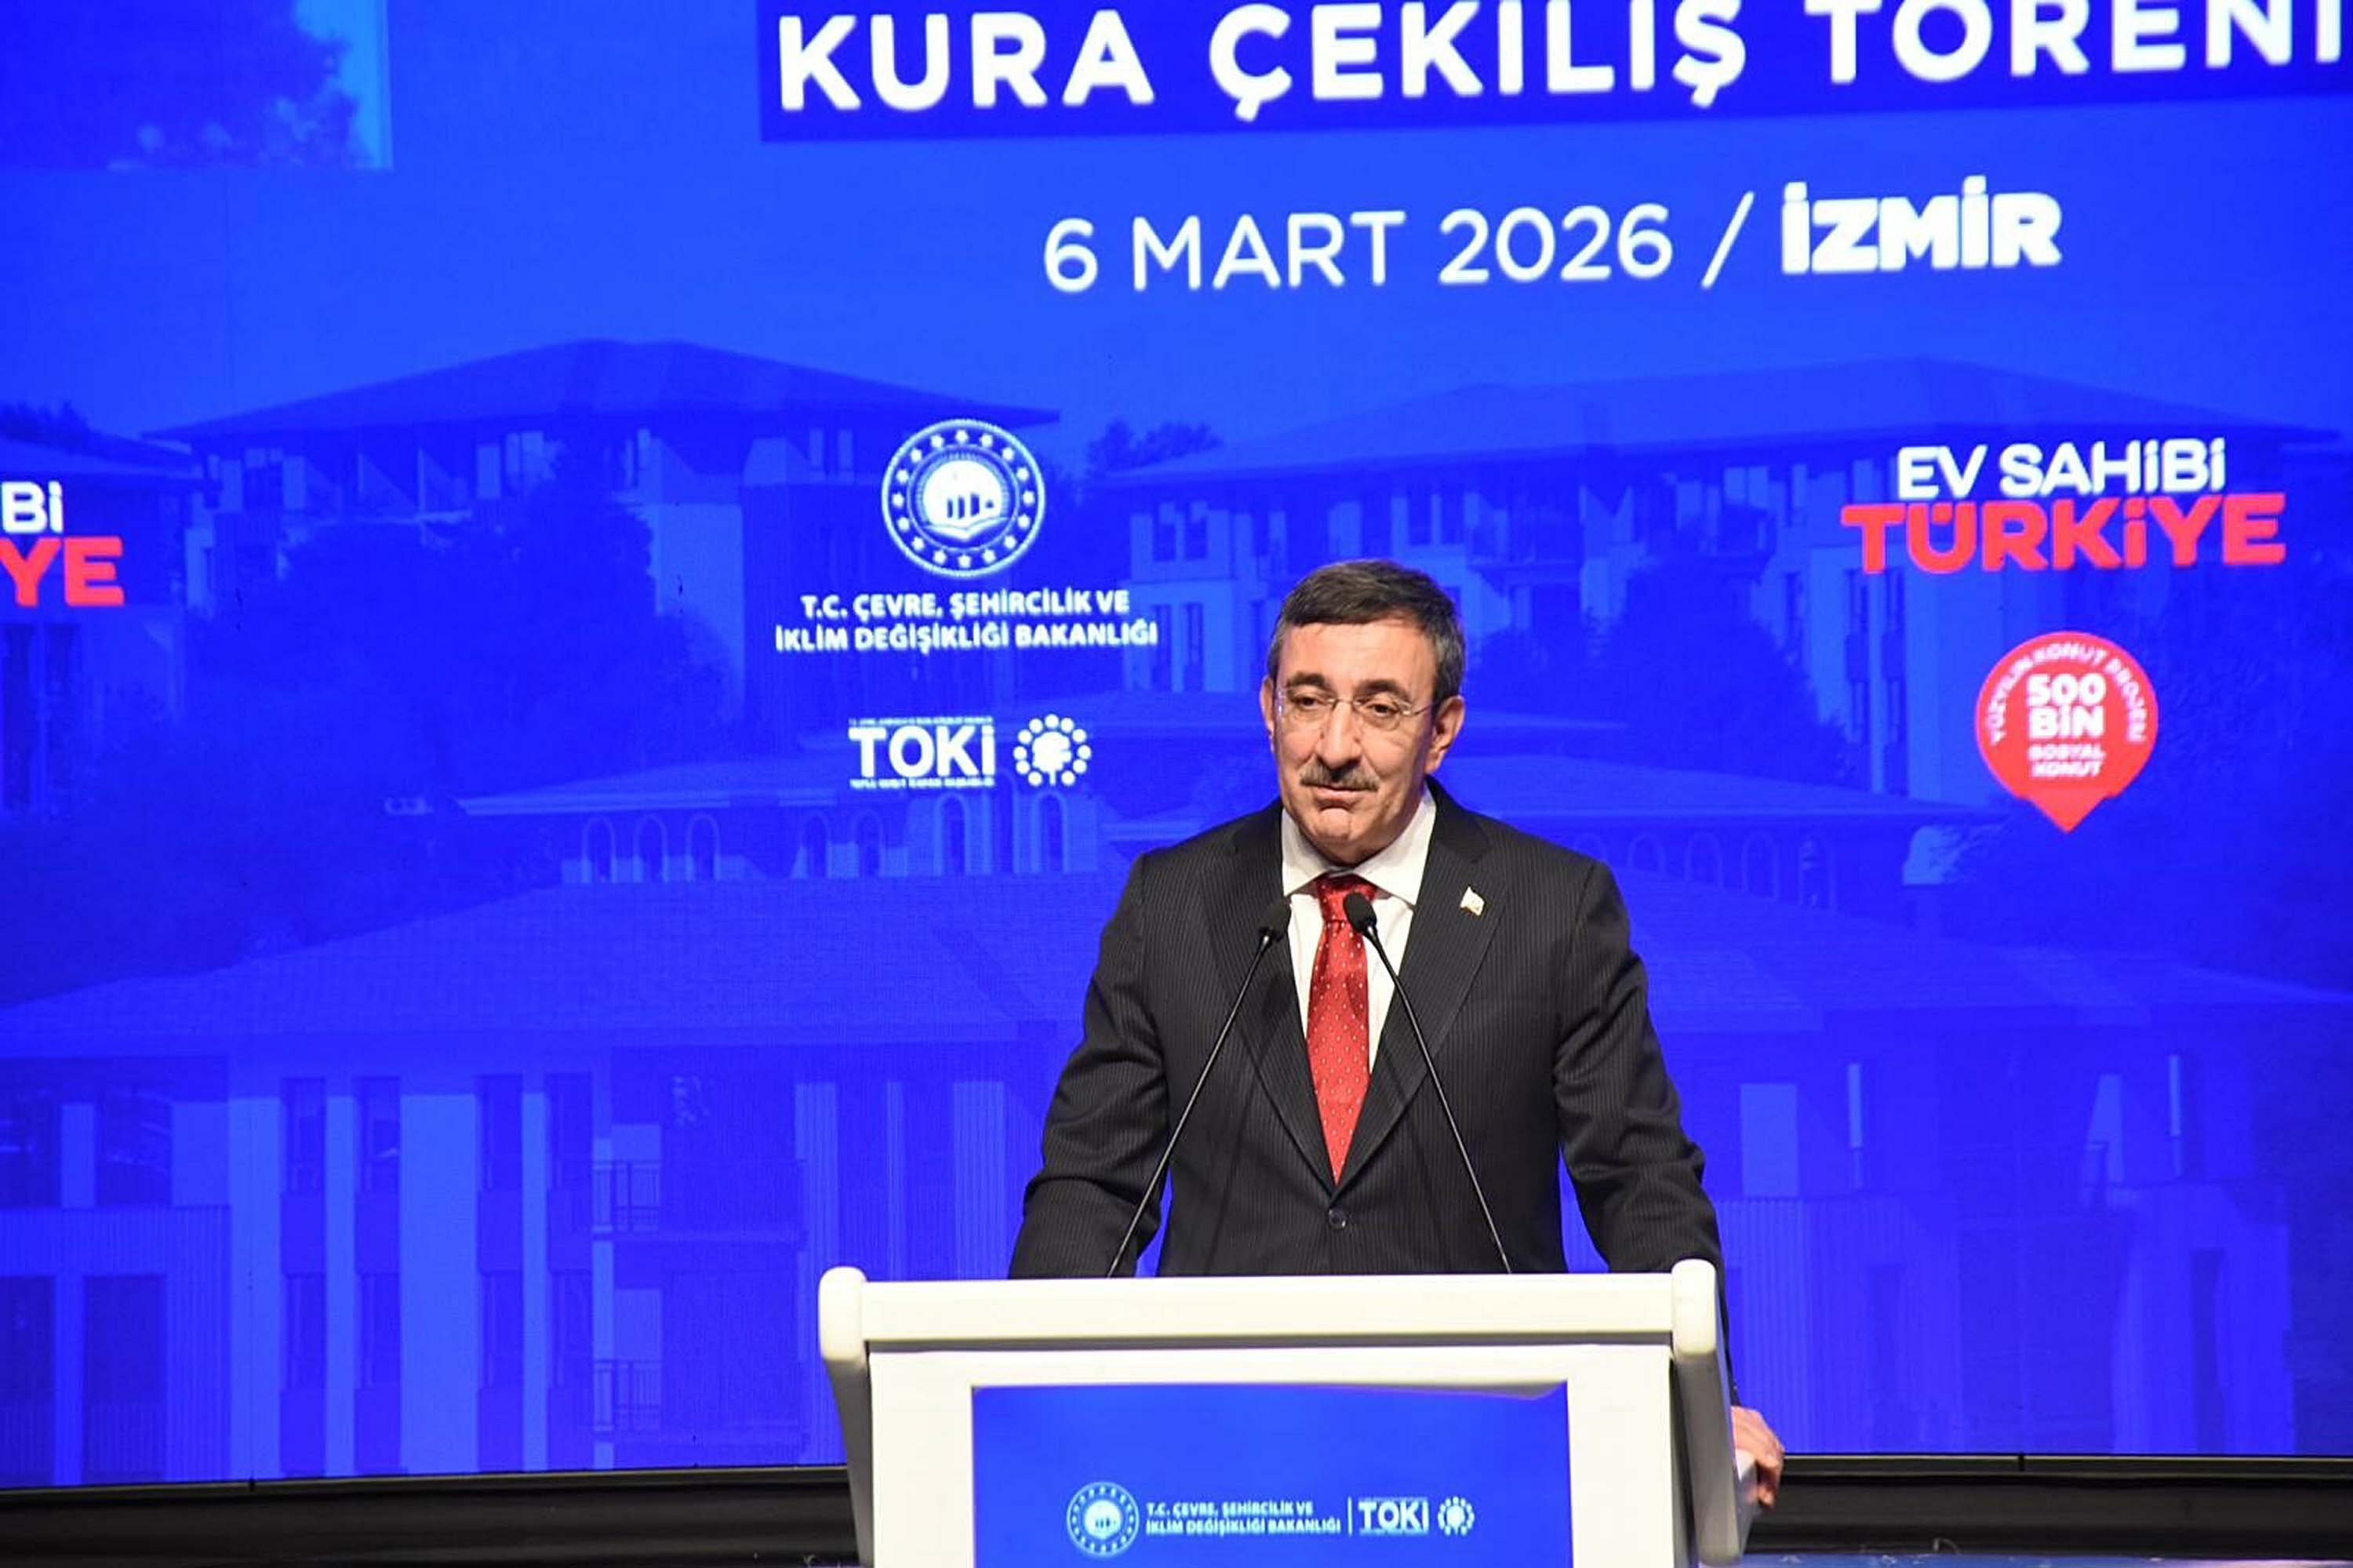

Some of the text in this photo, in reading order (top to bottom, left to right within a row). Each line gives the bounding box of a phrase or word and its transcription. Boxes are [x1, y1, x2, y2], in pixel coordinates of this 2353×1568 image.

[779, 9, 1154, 110] KURA
[1043, 176, 2063, 292] 6 MART 2026 / İZMİR
[1897, 437, 2226, 500] EV SAHİBİ
[1841, 493, 2286, 574] TÜRKİYE
[800, 594, 848, 620] T.C.
[853, 593, 944, 623] ÇEVRE,
[1095, 589, 1130, 615] VE
[776, 624, 848, 652] İKLİM
[2027, 673, 2107, 707] 500
[848, 725, 995, 778] TOKİ
[1296, 1501, 1314, 1516] VE
